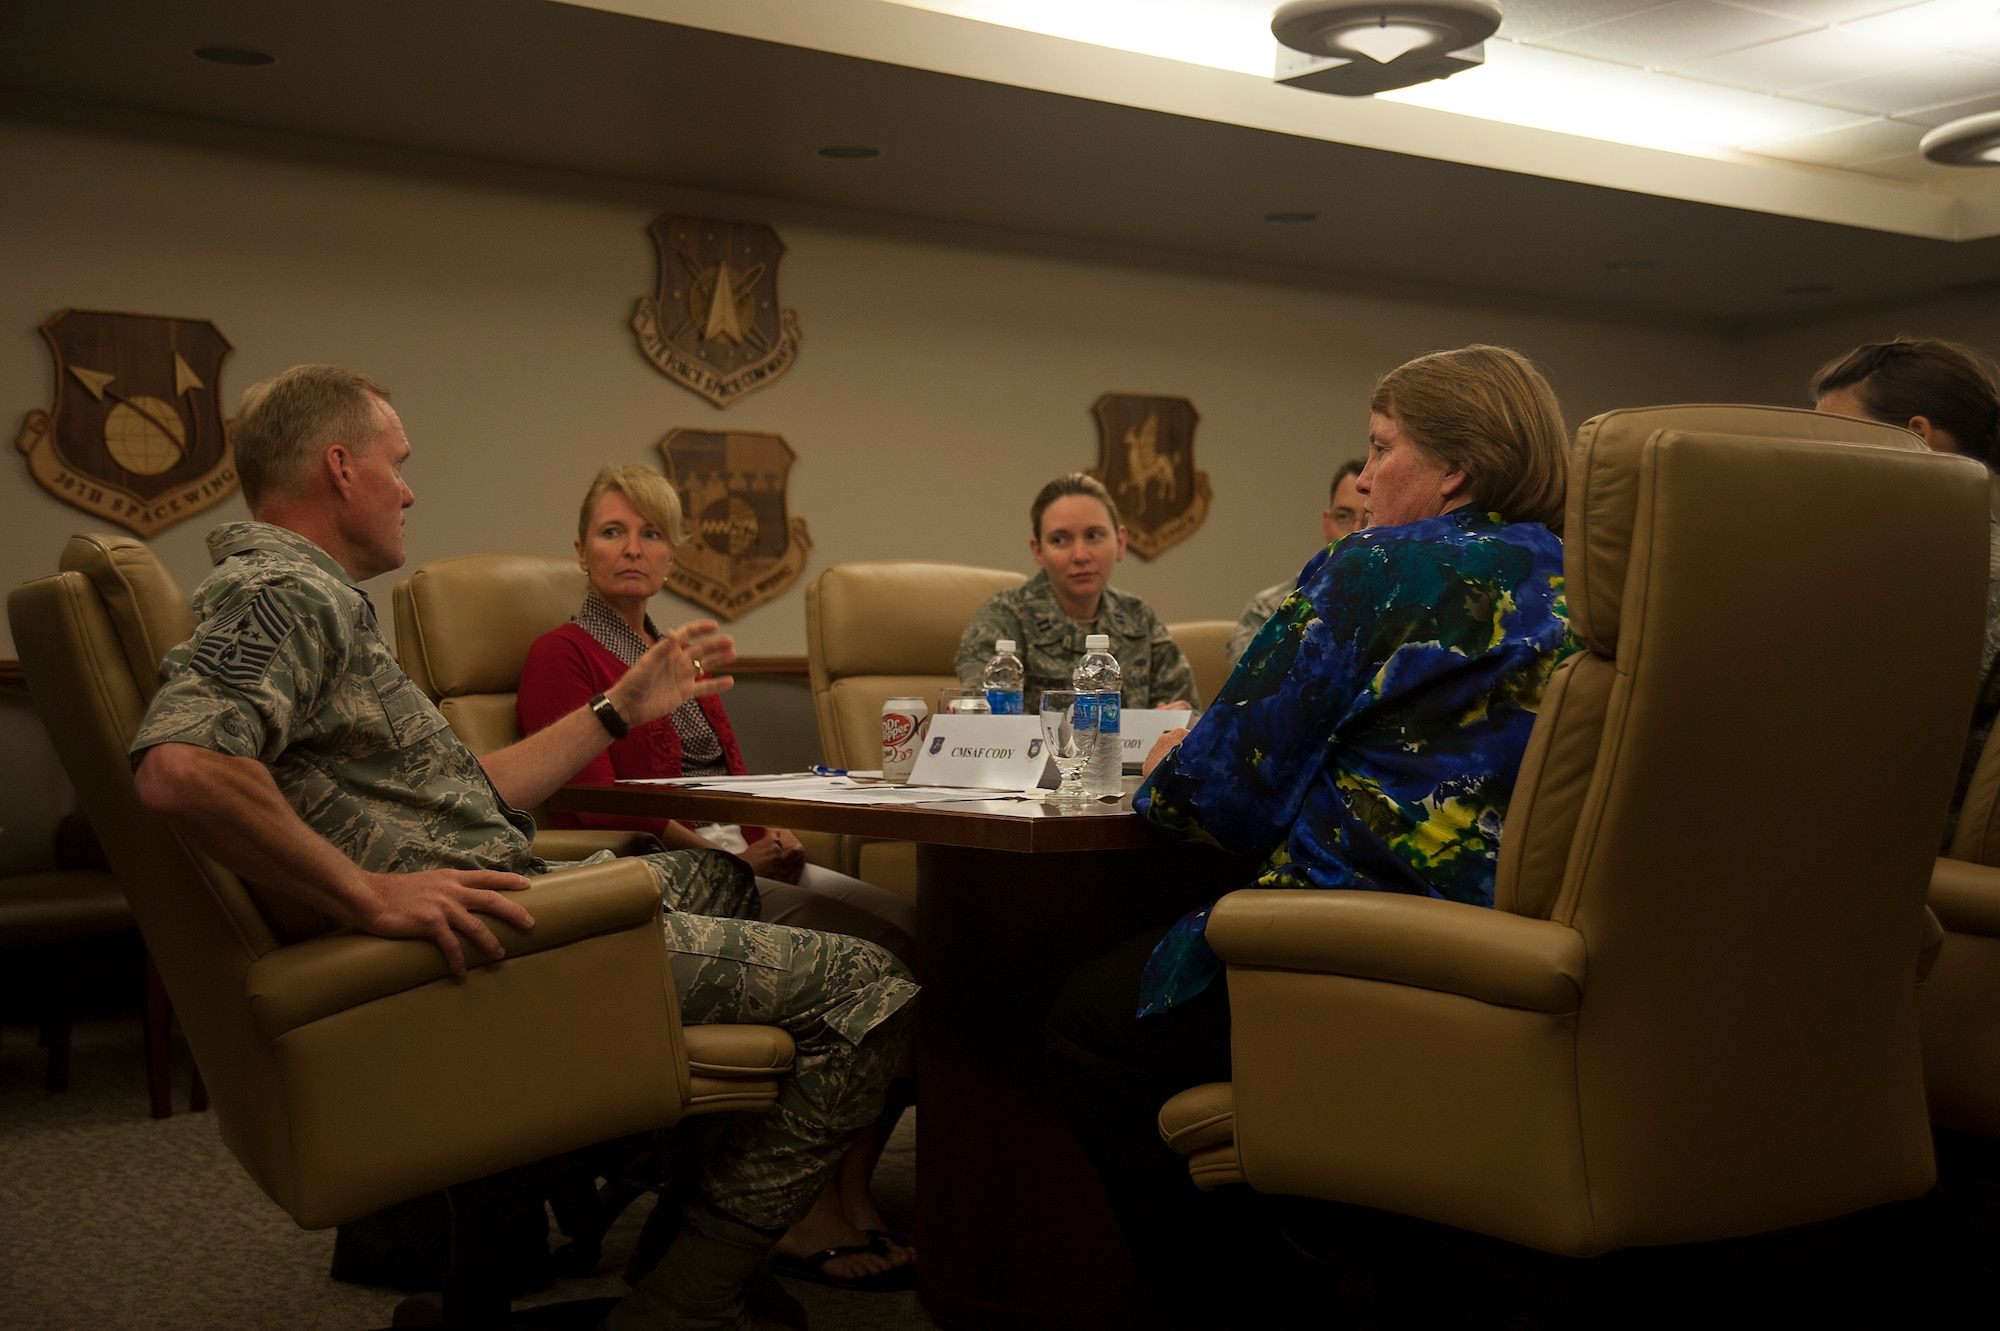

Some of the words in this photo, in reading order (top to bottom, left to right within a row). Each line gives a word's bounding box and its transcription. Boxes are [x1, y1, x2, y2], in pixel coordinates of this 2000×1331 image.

[666, 354, 703, 383] FORCE
[110, 498, 182, 523] SPACE
[183, 468, 235, 505] WING
[886, 718, 900, 730] Dr
[951, 747, 985, 758] CMSAF
[985, 748, 1016, 760] CODY
